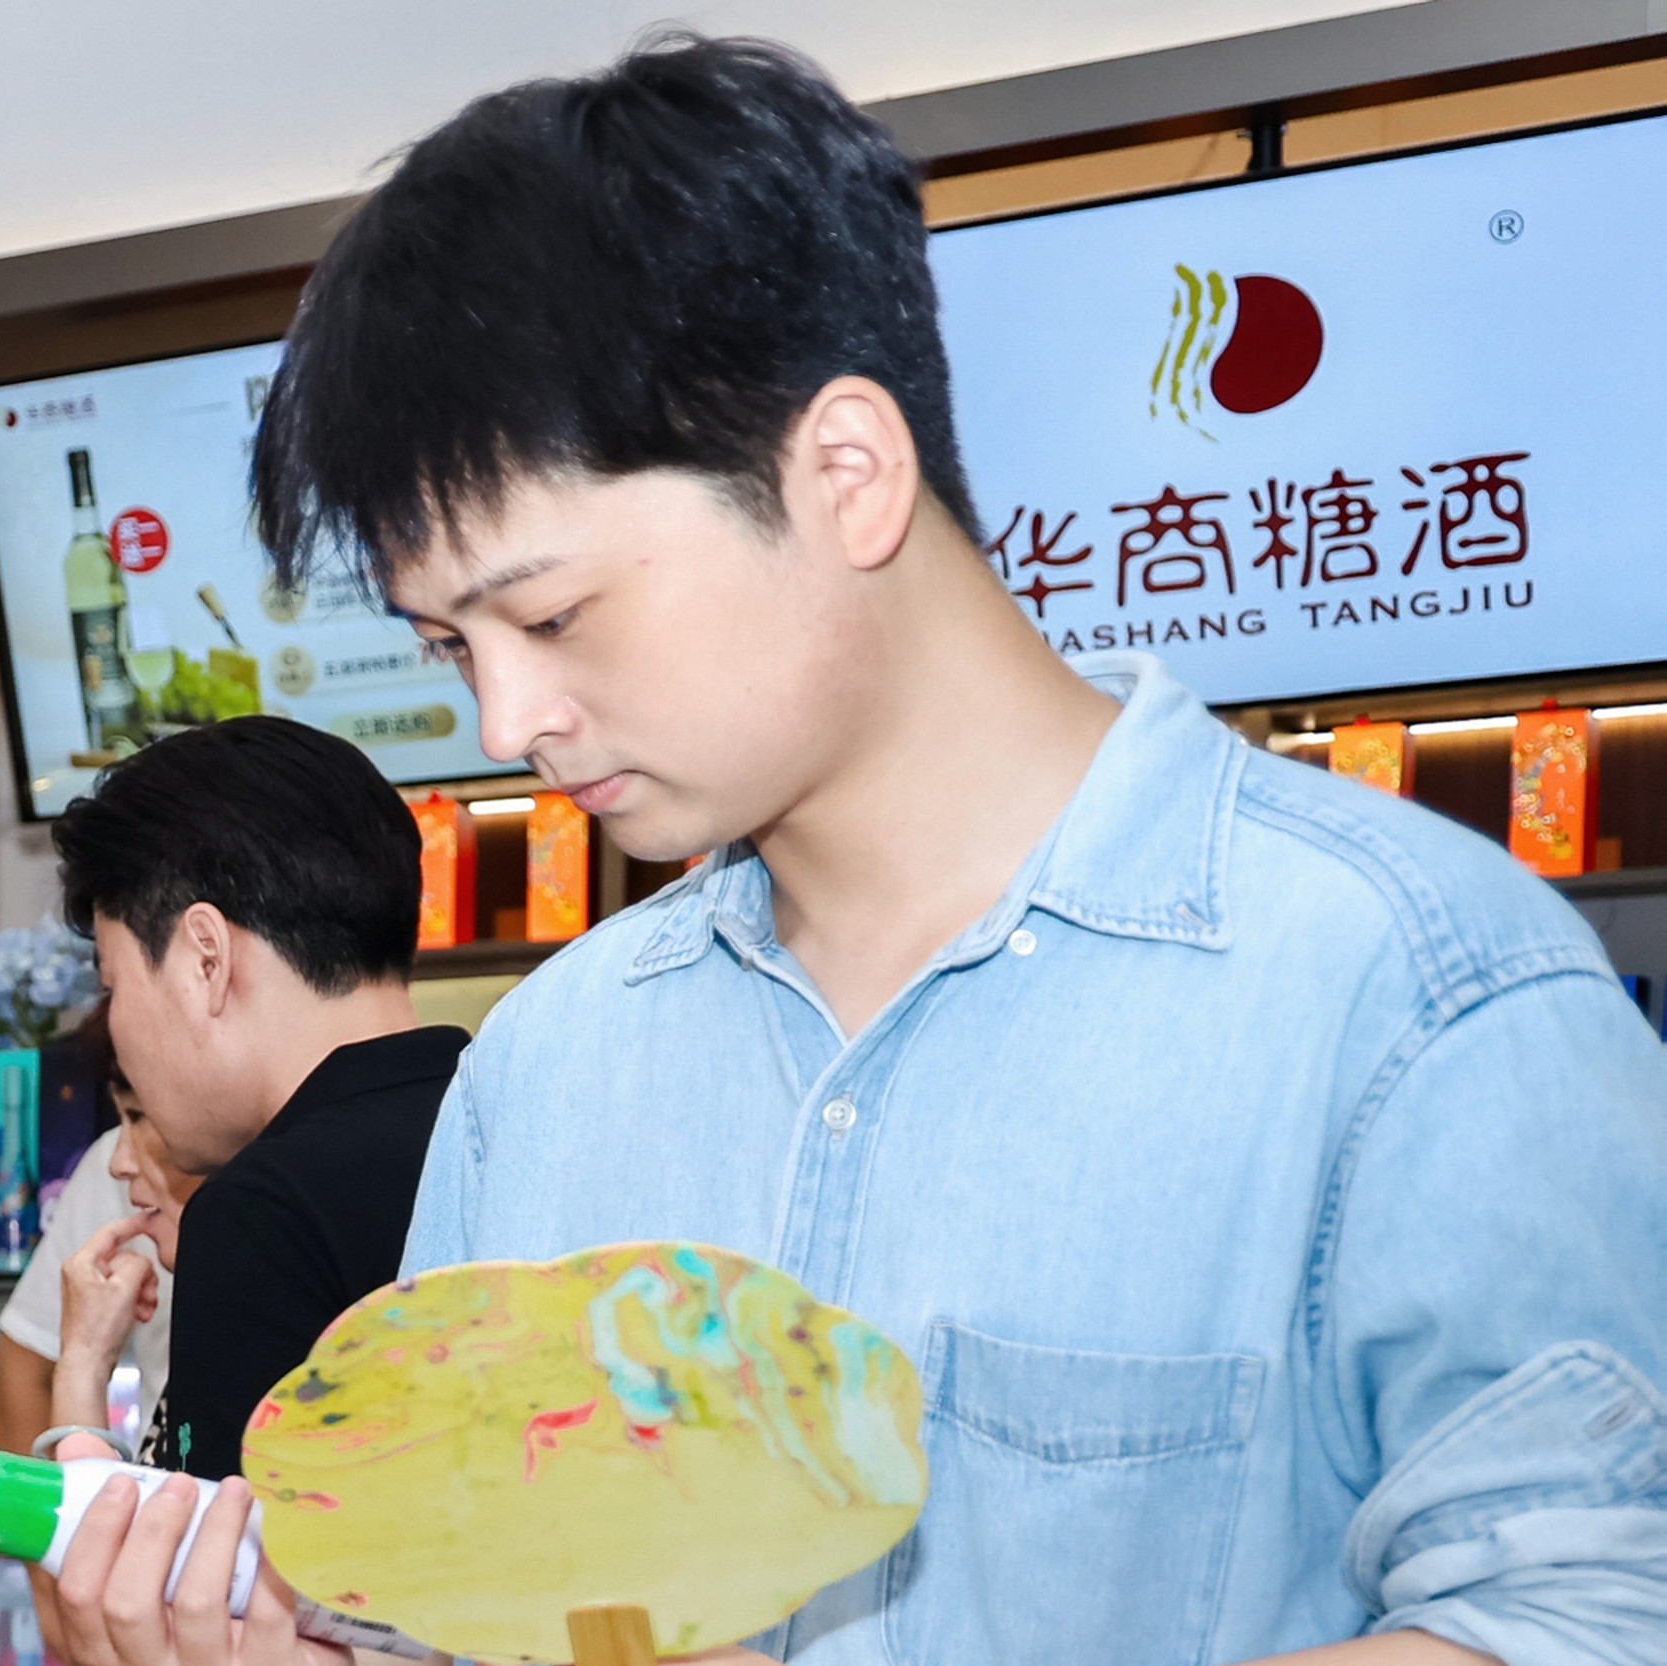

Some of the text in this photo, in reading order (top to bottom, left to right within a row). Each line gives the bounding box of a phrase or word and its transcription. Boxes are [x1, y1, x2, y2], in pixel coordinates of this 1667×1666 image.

[988, 451, 1531, 618] 华商糖酒
[1044, 580, 1535, 655] ASHANG TANGJIU
